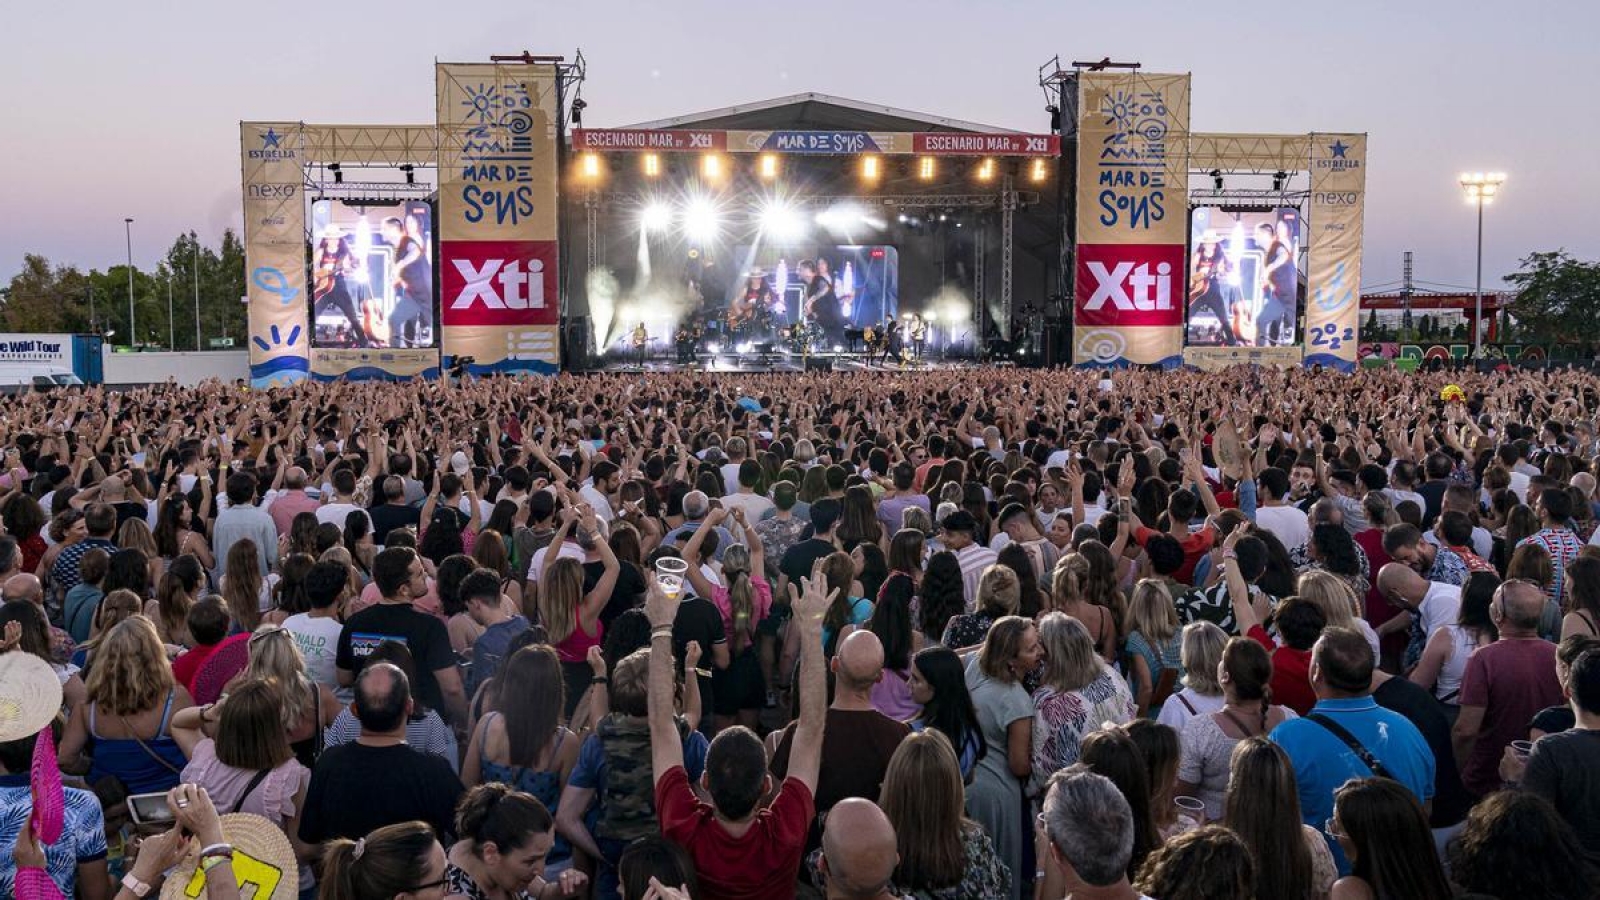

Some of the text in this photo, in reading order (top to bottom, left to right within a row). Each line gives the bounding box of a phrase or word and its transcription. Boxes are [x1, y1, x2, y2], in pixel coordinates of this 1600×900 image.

[586, 132, 645, 146] ESCENARIO
[649, 133, 673, 147] MAR
[690, 133, 713, 147] Xti
[777, 134, 806, 149] MAR
[810, 135, 830, 149] DE
[926, 136, 984, 150] ESCENARIO
[988, 137, 1010, 150] MAR
[1026, 138, 1048, 152] Xti
[248, 150, 296, 158] ESTRELLA
[1316, 159, 1360, 169] ESTRELLA
[463, 164, 534, 182] MAR DE
[1099, 170, 1165, 188] MAR DE
[248, 184, 295, 197] nexo
[1314, 192, 1357, 205] nexo
[450, 259, 546, 309] Xti
[1083, 262, 1173, 310] Xti
[9, 340, 34, 352] Wild
[36, 340, 61, 352] Tour
